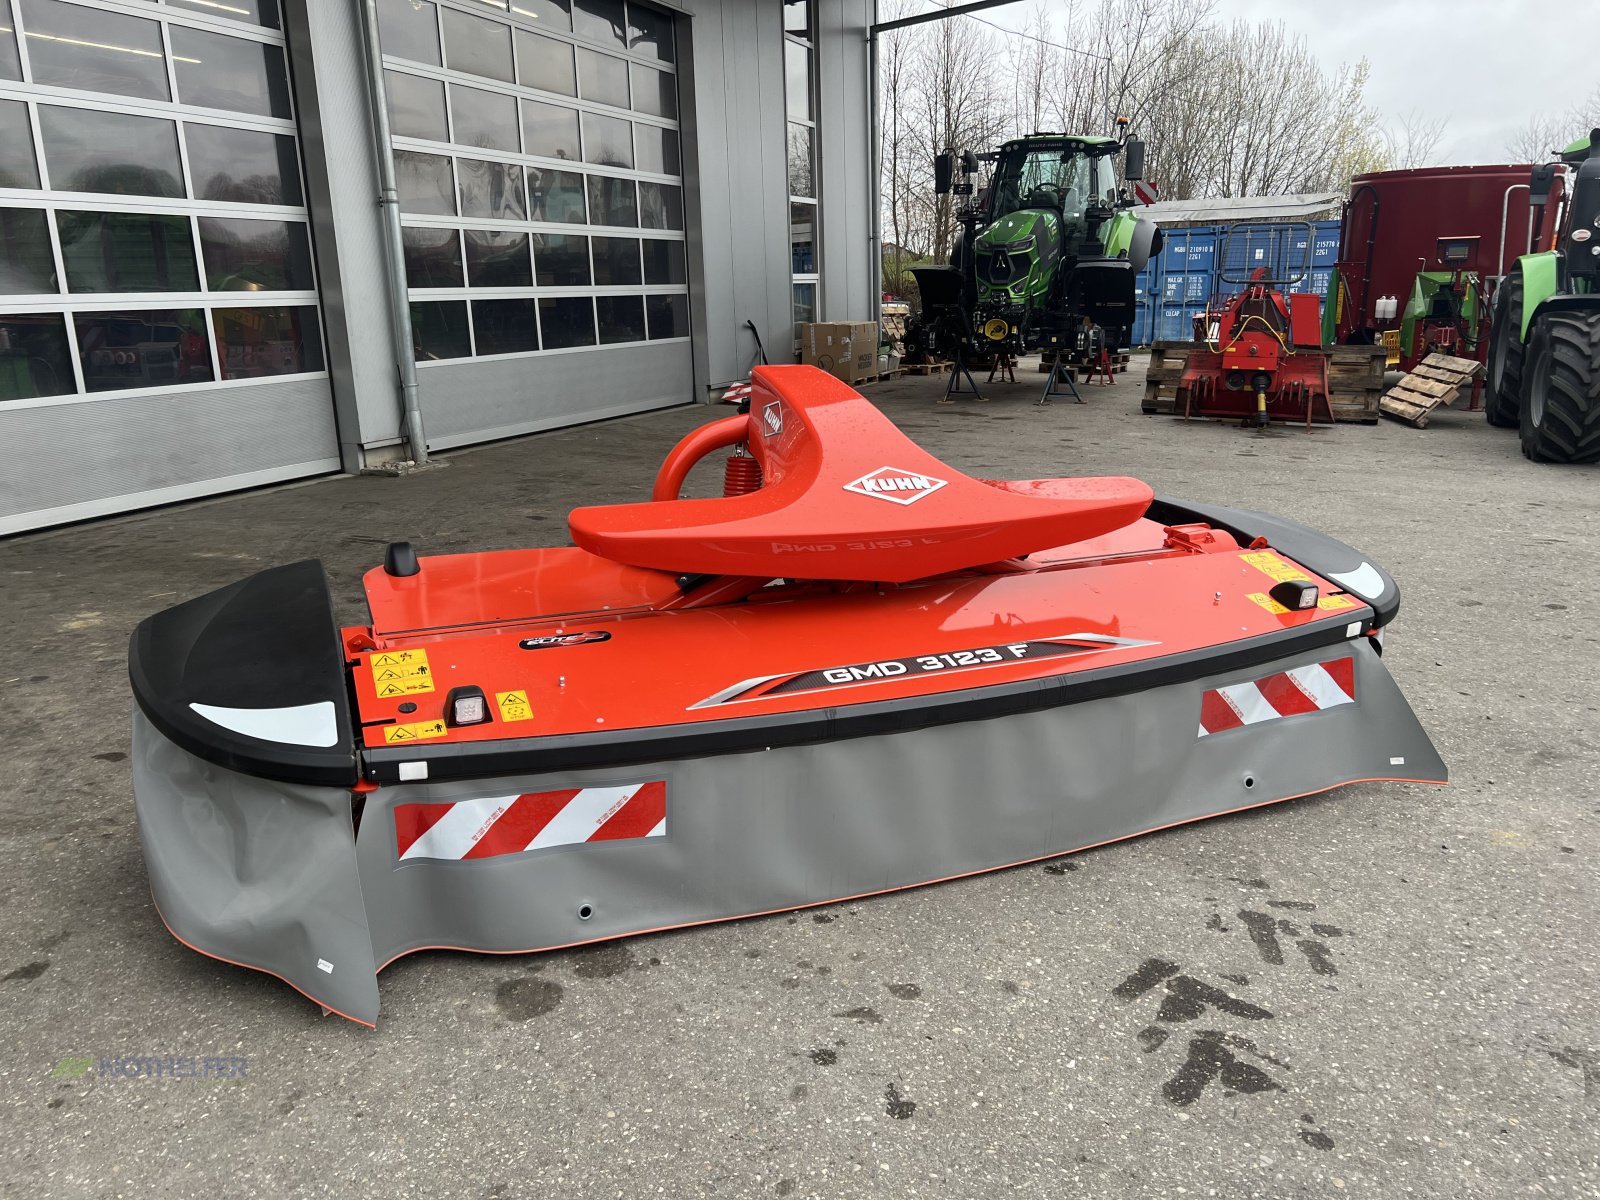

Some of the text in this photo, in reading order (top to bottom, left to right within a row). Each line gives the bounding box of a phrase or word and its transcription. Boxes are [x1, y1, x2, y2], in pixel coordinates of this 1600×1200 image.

[763, 407, 781, 433] KUHN
[861, 476, 933, 493] KUHN
[822, 644, 1029, 684] GMD 3123 F
